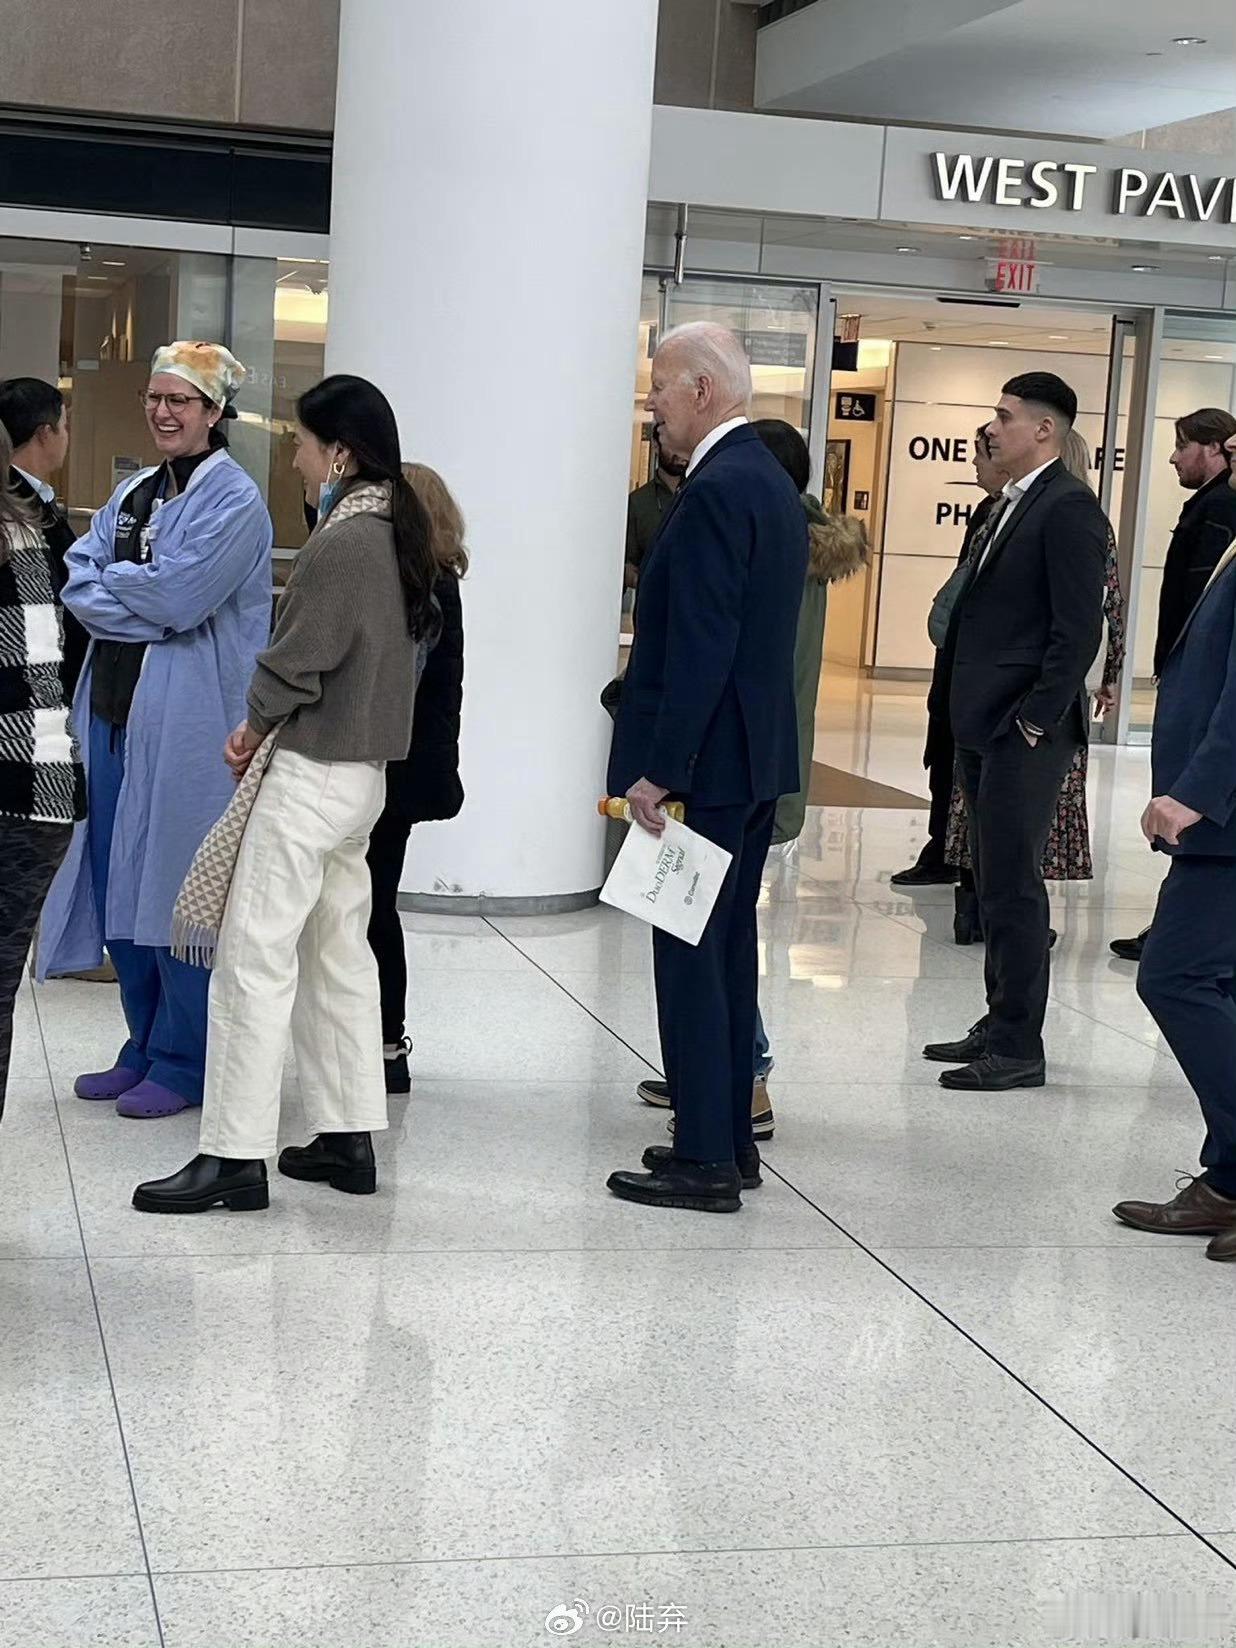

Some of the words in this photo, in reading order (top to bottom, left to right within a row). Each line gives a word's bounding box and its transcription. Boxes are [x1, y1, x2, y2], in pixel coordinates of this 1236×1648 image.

[934, 152, 1098, 211] WEST
[995, 262, 1036, 292] EXIT
[908, 436, 968, 463] ONE
[645, 847, 675, 904] DuoDERM
[671, 846, 685, 875] Signal
